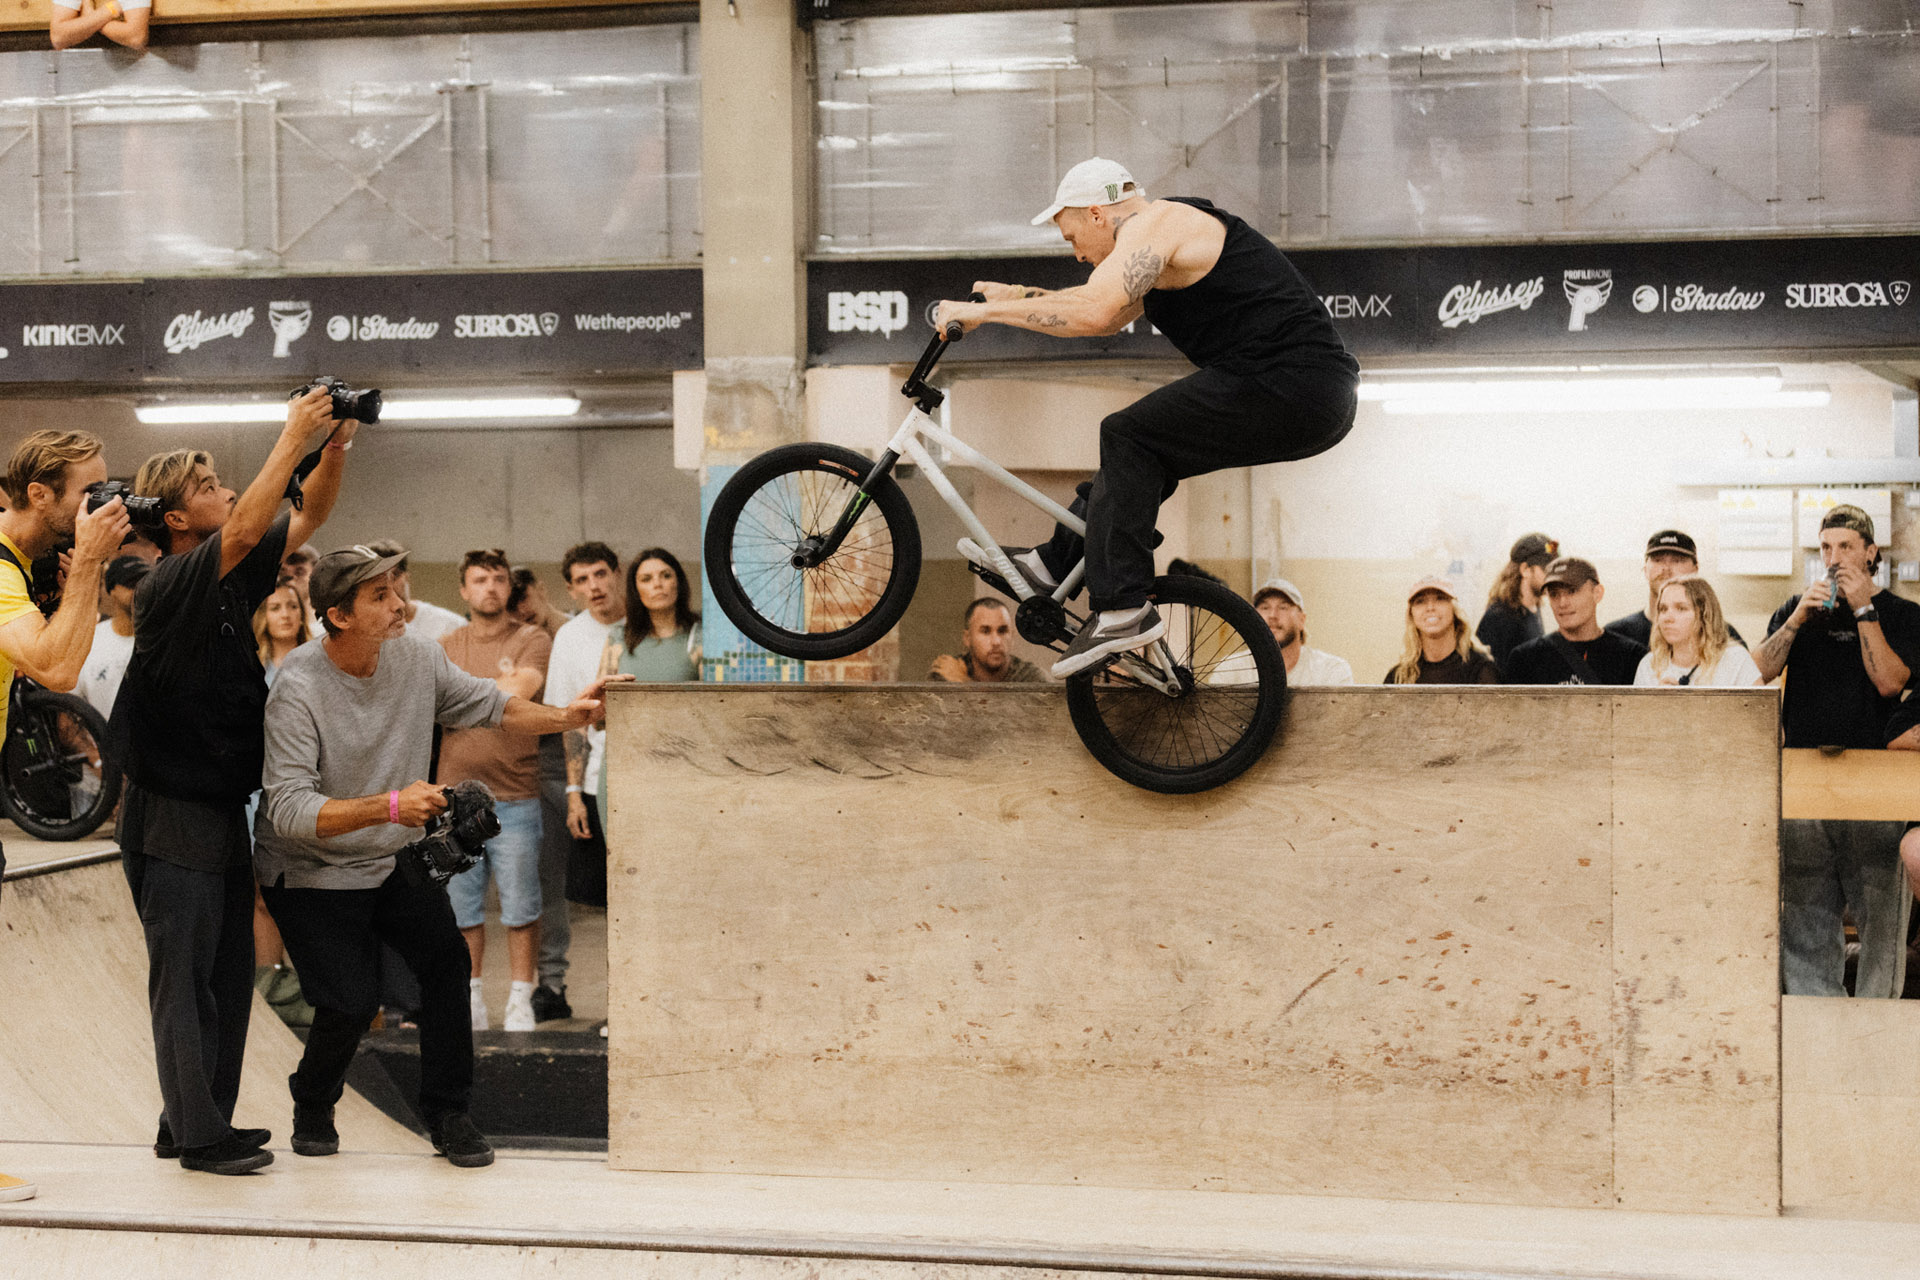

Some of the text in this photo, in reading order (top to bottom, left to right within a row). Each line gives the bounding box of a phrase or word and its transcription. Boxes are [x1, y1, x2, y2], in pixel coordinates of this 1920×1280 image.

[1437, 276, 1544, 328] Odyssey
[1670, 283, 1766, 313] Shadow
[1785, 281, 1889, 309] SUBROSA
[163, 306, 255, 354] Odyssey
[358, 314, 440, 342] Shadow
[453, 313, 541, 338] SUBROSA
[827, 290, 909, 340] BSD
